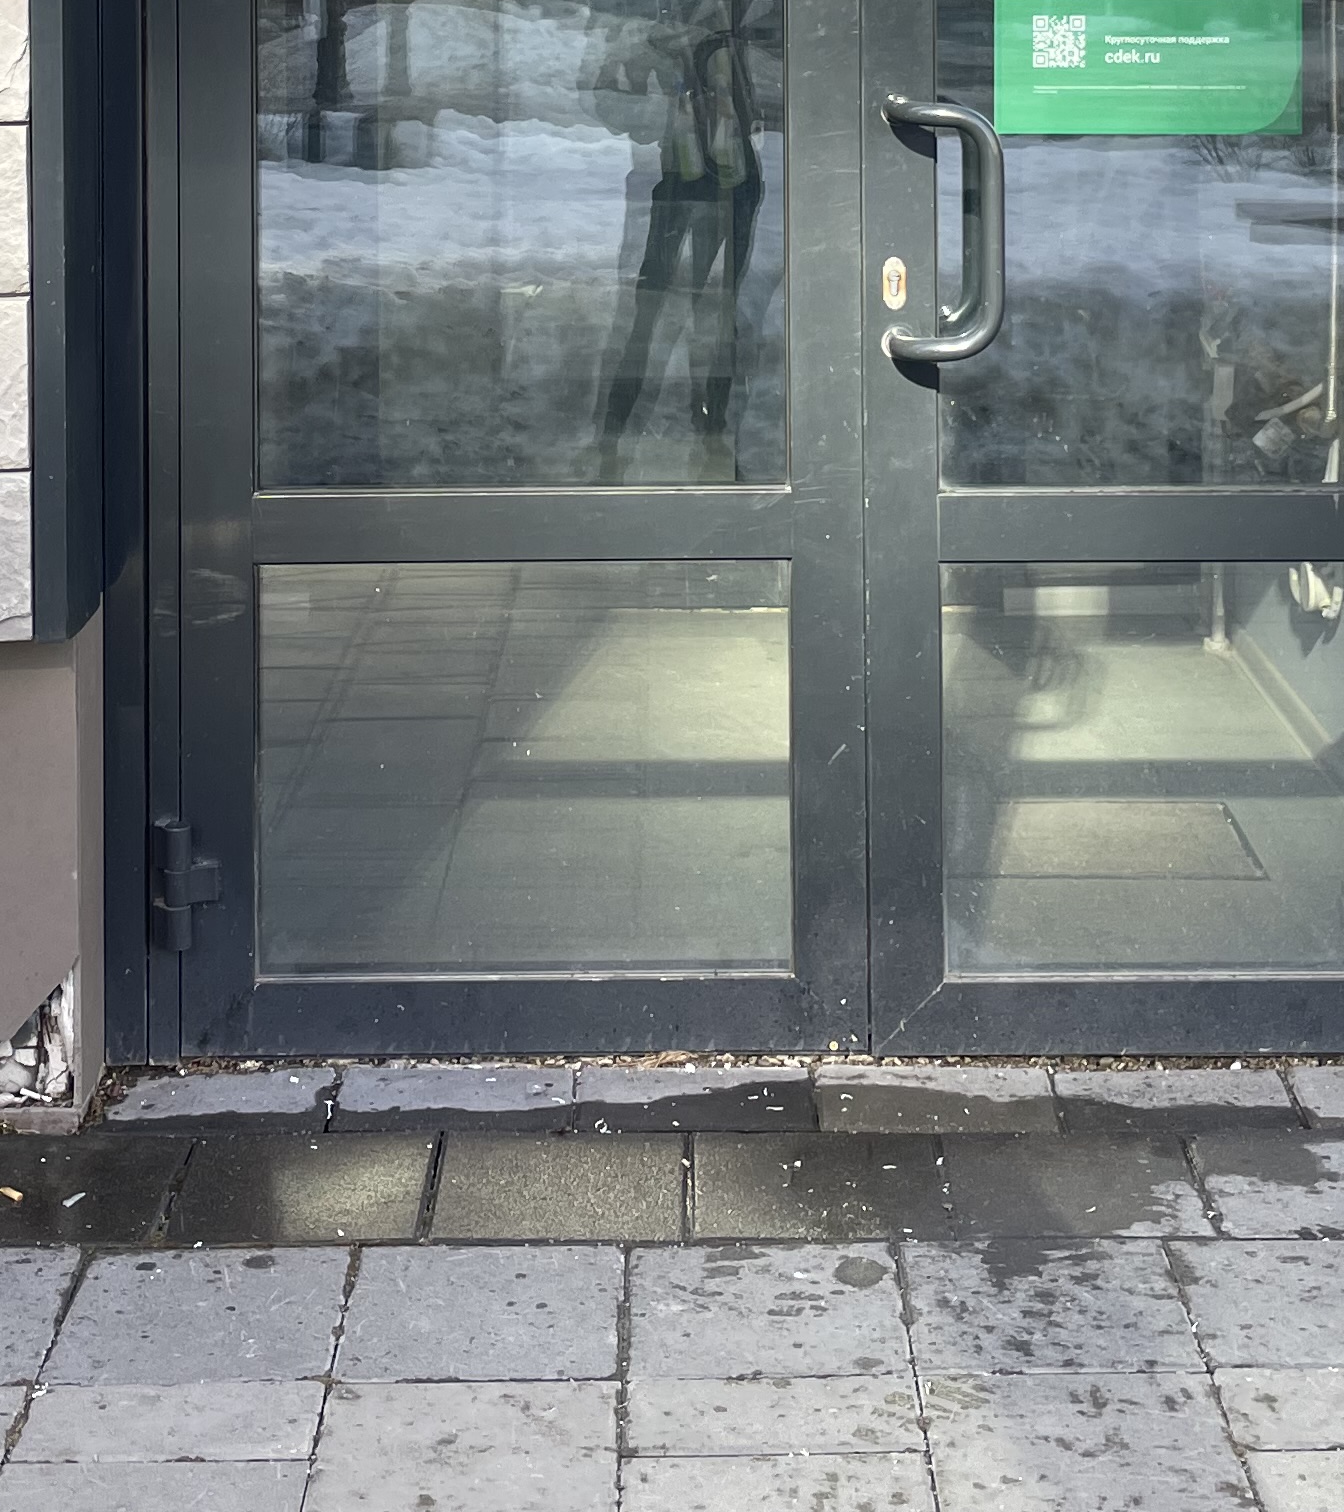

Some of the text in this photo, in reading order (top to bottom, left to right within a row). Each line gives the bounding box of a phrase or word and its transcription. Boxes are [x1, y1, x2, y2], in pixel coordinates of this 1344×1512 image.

[1104, 35, 1230, 46] Круглосуточная поддержка
[1104, 48, 1161, 64] cdek.ru
